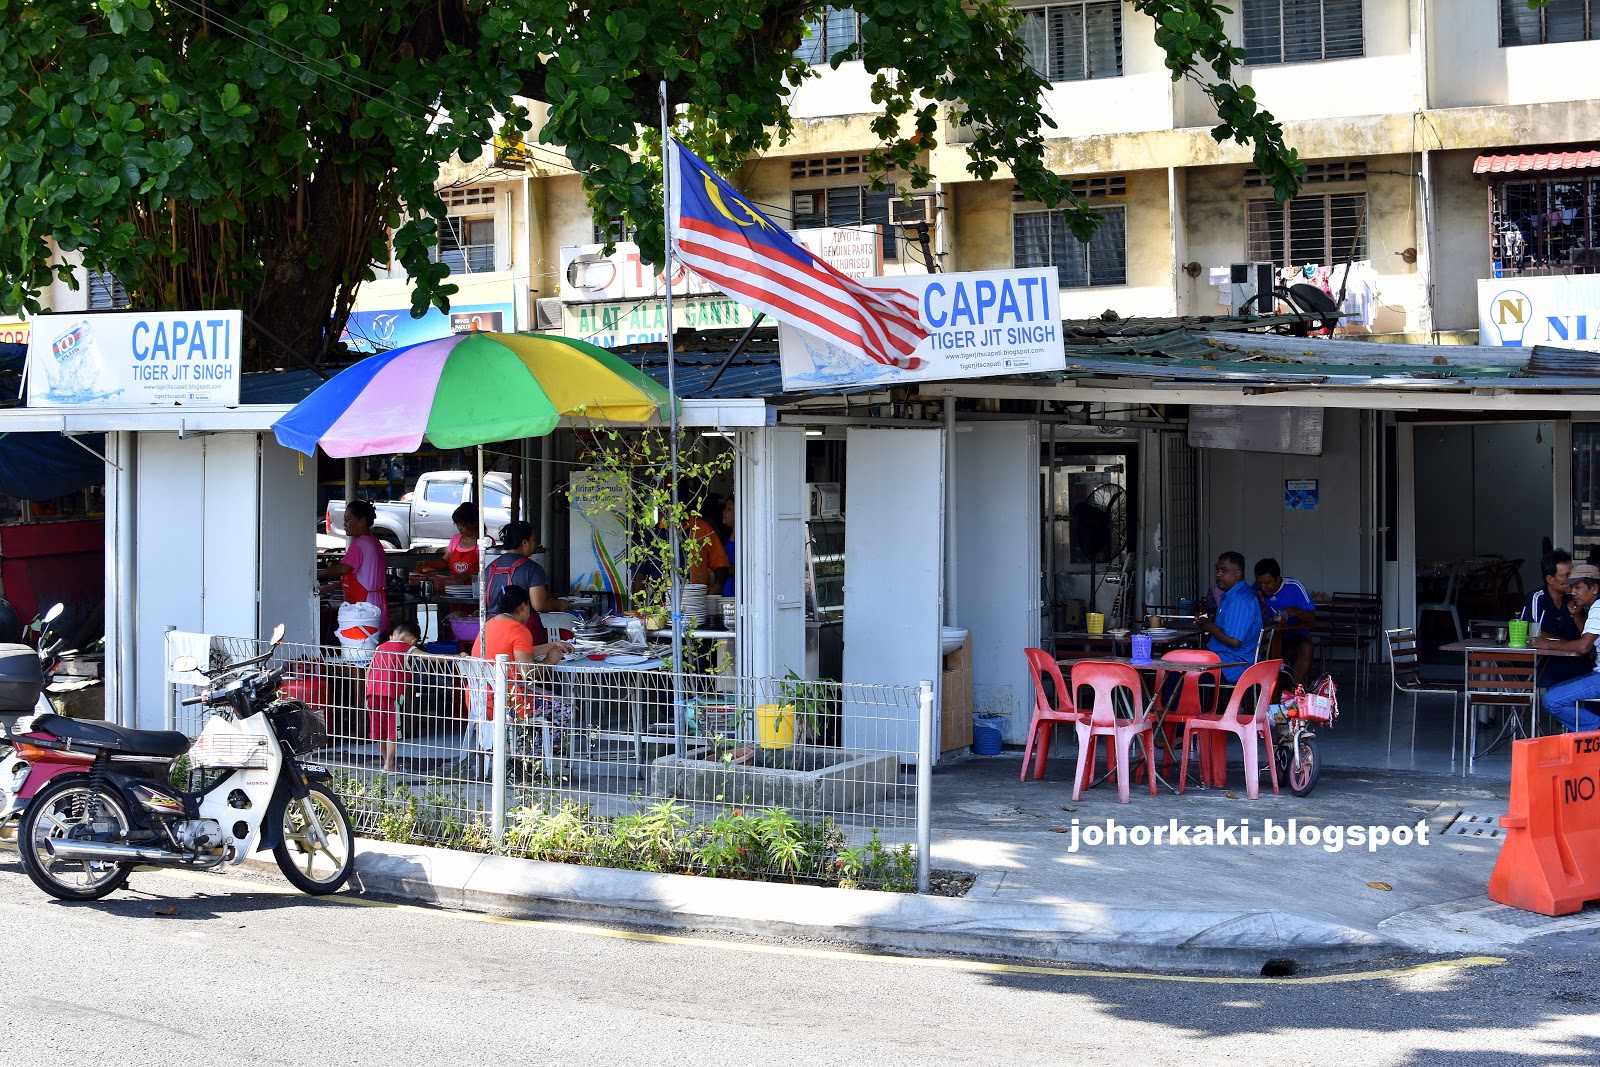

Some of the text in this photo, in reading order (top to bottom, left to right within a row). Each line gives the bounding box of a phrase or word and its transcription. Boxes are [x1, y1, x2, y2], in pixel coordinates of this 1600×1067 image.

[823, 243, 873, 257] GENUINE PARTS
[834, 231, 861, 243] TOYOTA
[924, 276, 1050, 329] CAPATI
[1498, 298, 1525, 325] N
[578, 303, 673, 332] ALAT-ALA
[686, 300, 739, 327] GANTI
[131, 319, 231, 362] CAPATI
[930, 325, 1056, 351] TIGER JIT SINGH
[945, 348, 1044, 360] www.tigerjitscapati.blogspot.com
[132, 364, 232, 381] TIGER JIT SINGH
[1565, 776, 1595, 805] NO
